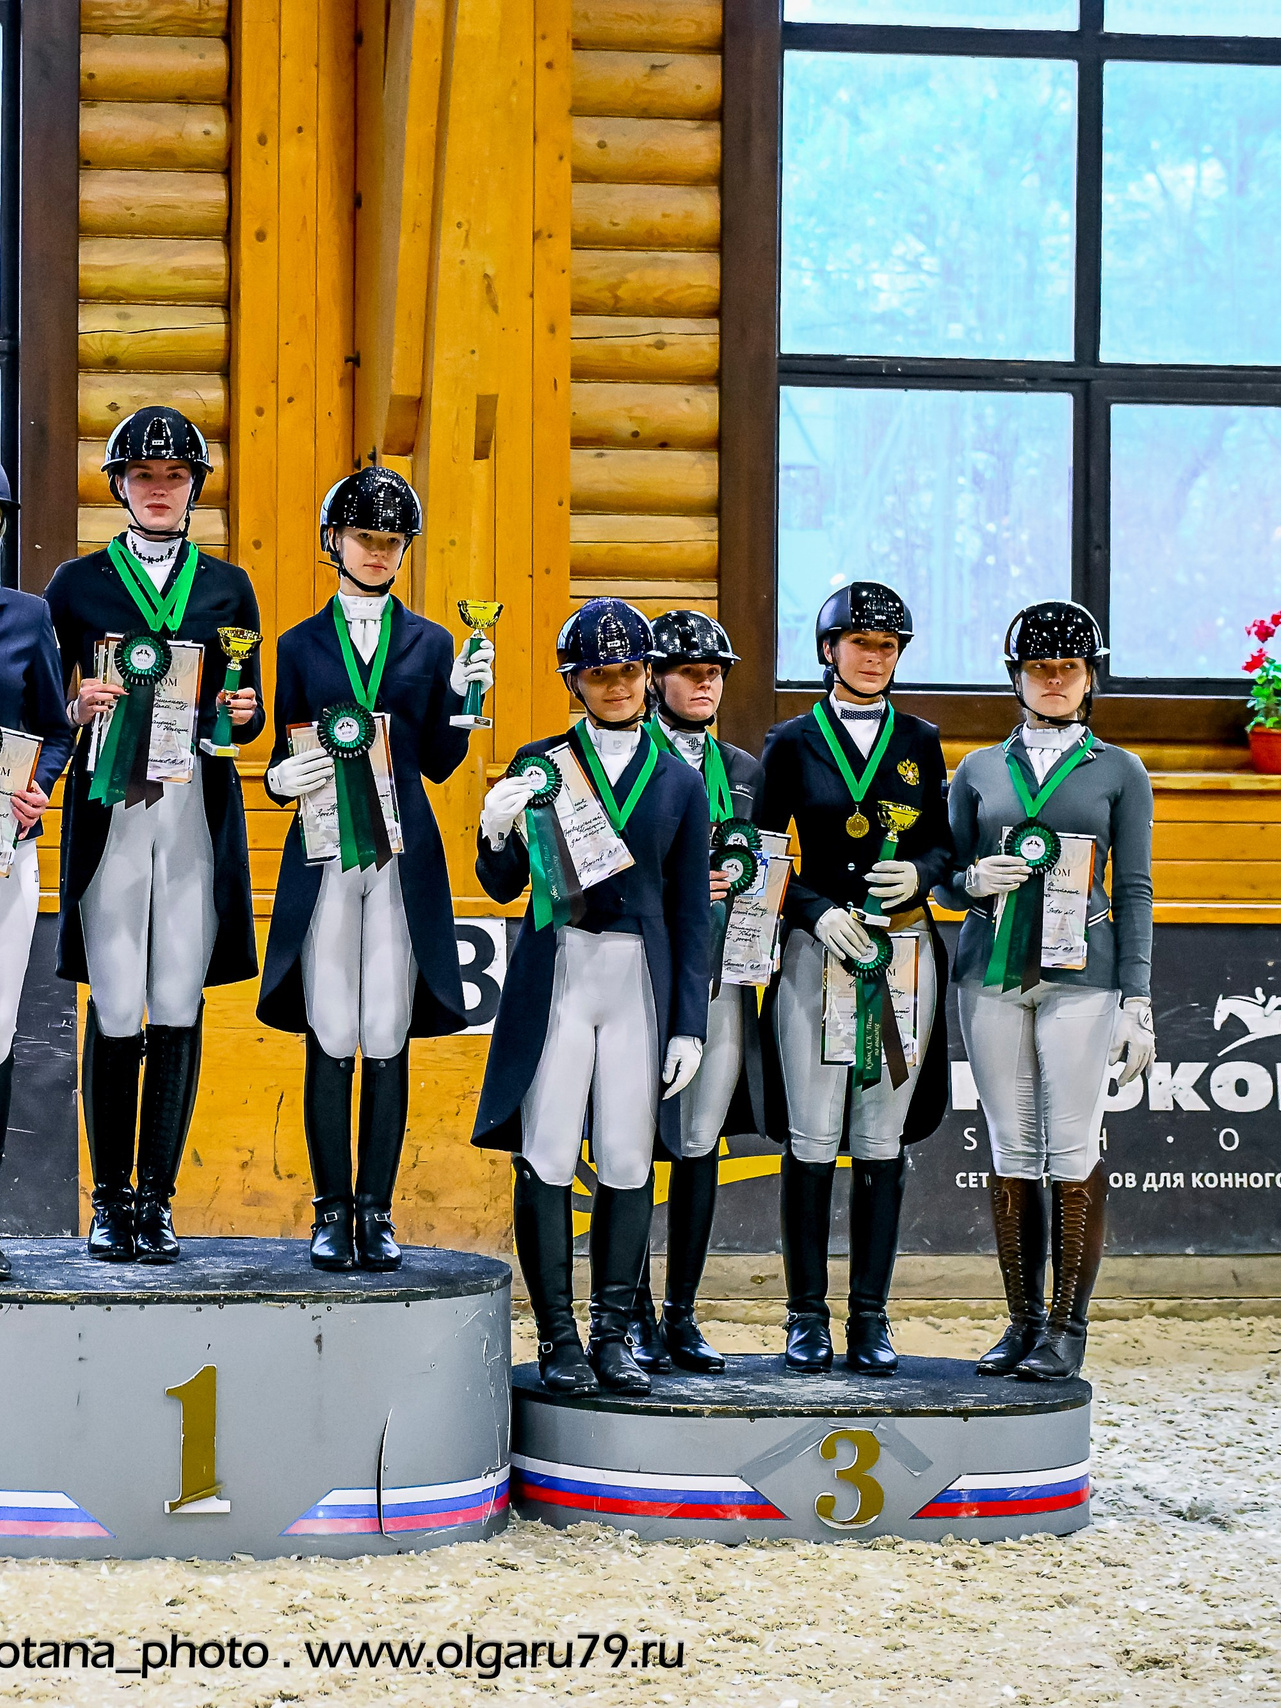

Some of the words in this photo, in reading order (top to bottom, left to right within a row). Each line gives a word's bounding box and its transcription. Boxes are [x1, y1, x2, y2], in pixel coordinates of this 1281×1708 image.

[1143, 1172, 1185, 1192] ДЛЯ
[163, 1363, 232, 1515] 1
[814, 1428, 885, 1530] 3
